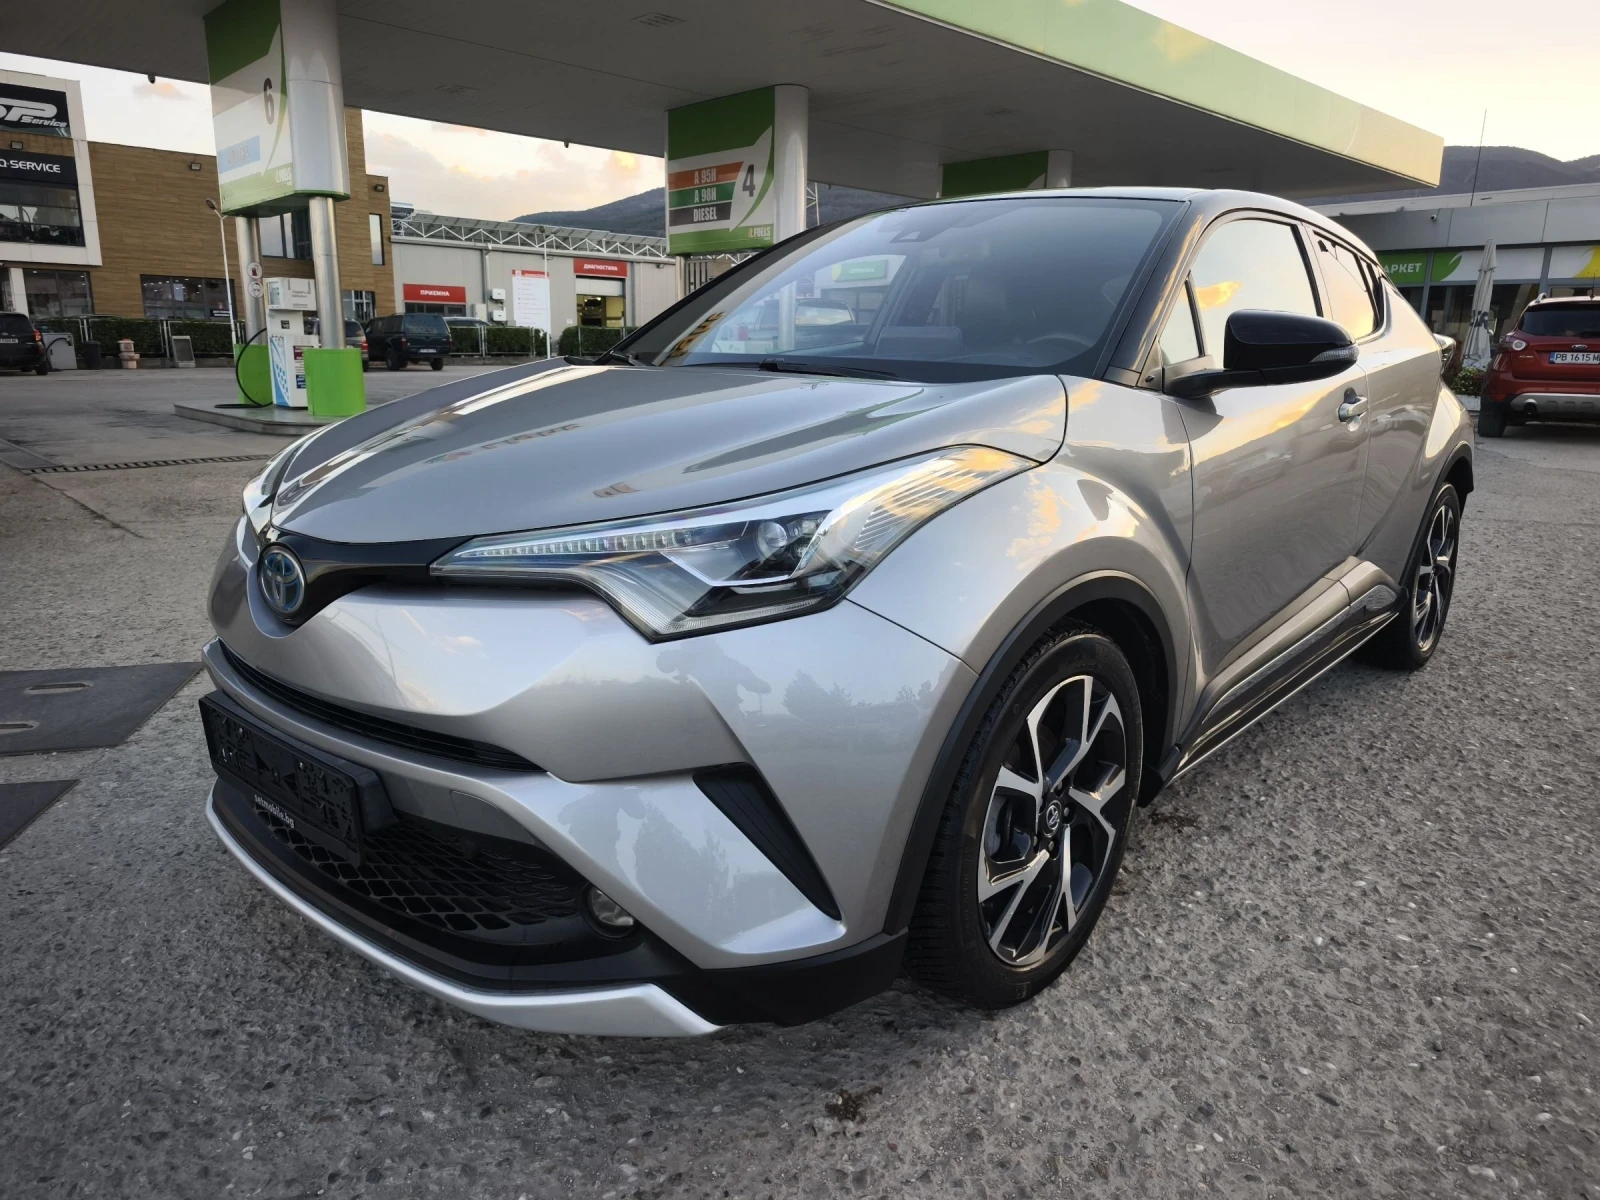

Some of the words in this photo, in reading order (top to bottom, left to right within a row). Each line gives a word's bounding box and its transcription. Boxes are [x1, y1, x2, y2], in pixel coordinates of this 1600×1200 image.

[264, 77, 275, 125] 6
[20, 115, 68, 128] Service
[742, 164, 756, 197] 4
[693, 206, 717, 222] DIESEL
[1384, 263, 1421, 274] АРКЕТ
[1570, 353, 1591, 362] 1615
